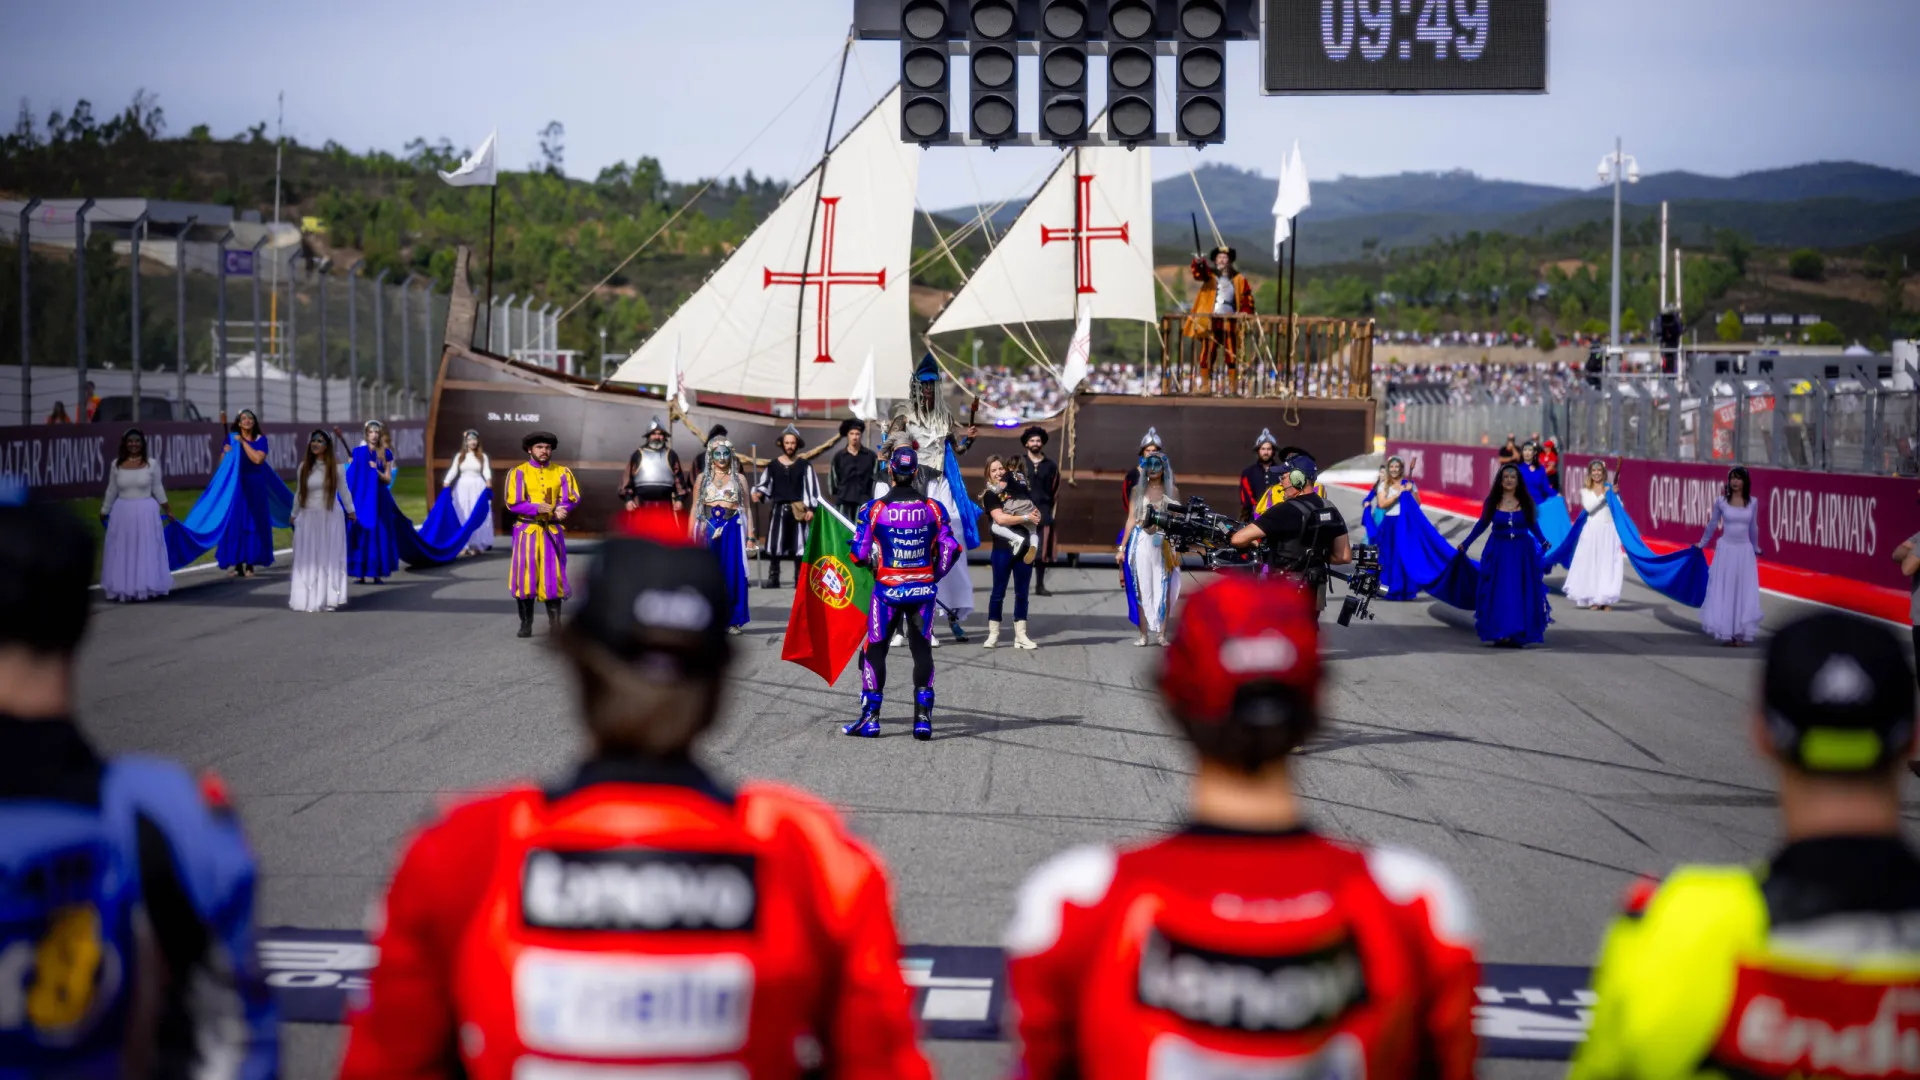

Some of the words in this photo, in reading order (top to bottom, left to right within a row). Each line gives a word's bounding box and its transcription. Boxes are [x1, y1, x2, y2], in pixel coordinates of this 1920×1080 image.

[1321, 0, 1490, 62] 09:49
[0, 437, 42, 487] ATAR
[44, 435, 105, 485] AIRWAYS
[888, 507, 927, 524] prim
[1649, 474, 1680, 530] QATAR
[1769, 486, 1812, 554] QATAR
[1814, 491, 1877, 557] AIRWAYS
